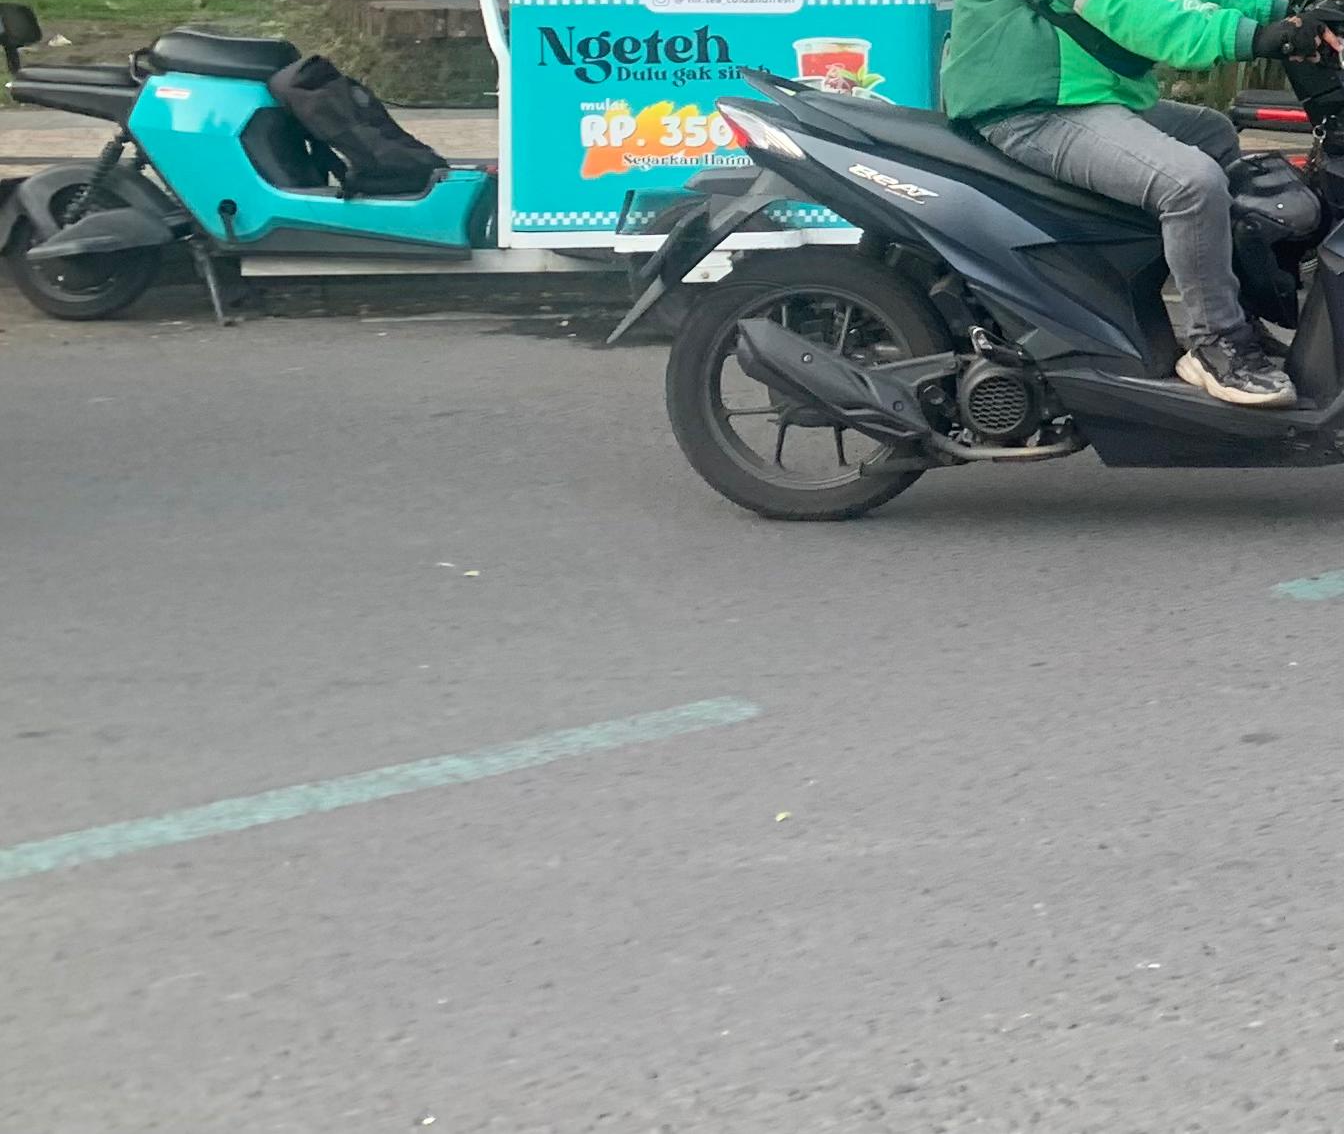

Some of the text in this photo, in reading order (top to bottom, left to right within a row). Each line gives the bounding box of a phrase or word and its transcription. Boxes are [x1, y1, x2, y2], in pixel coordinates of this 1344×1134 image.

[537, 24, 732, 84] Ngeteh
[616, 66, 667, 82] Dulu
[672, 66, 713, 88] gak
[580, 114, 734, 147] RP. 350
[623, 152, 754, 170] Segarkan Harim
